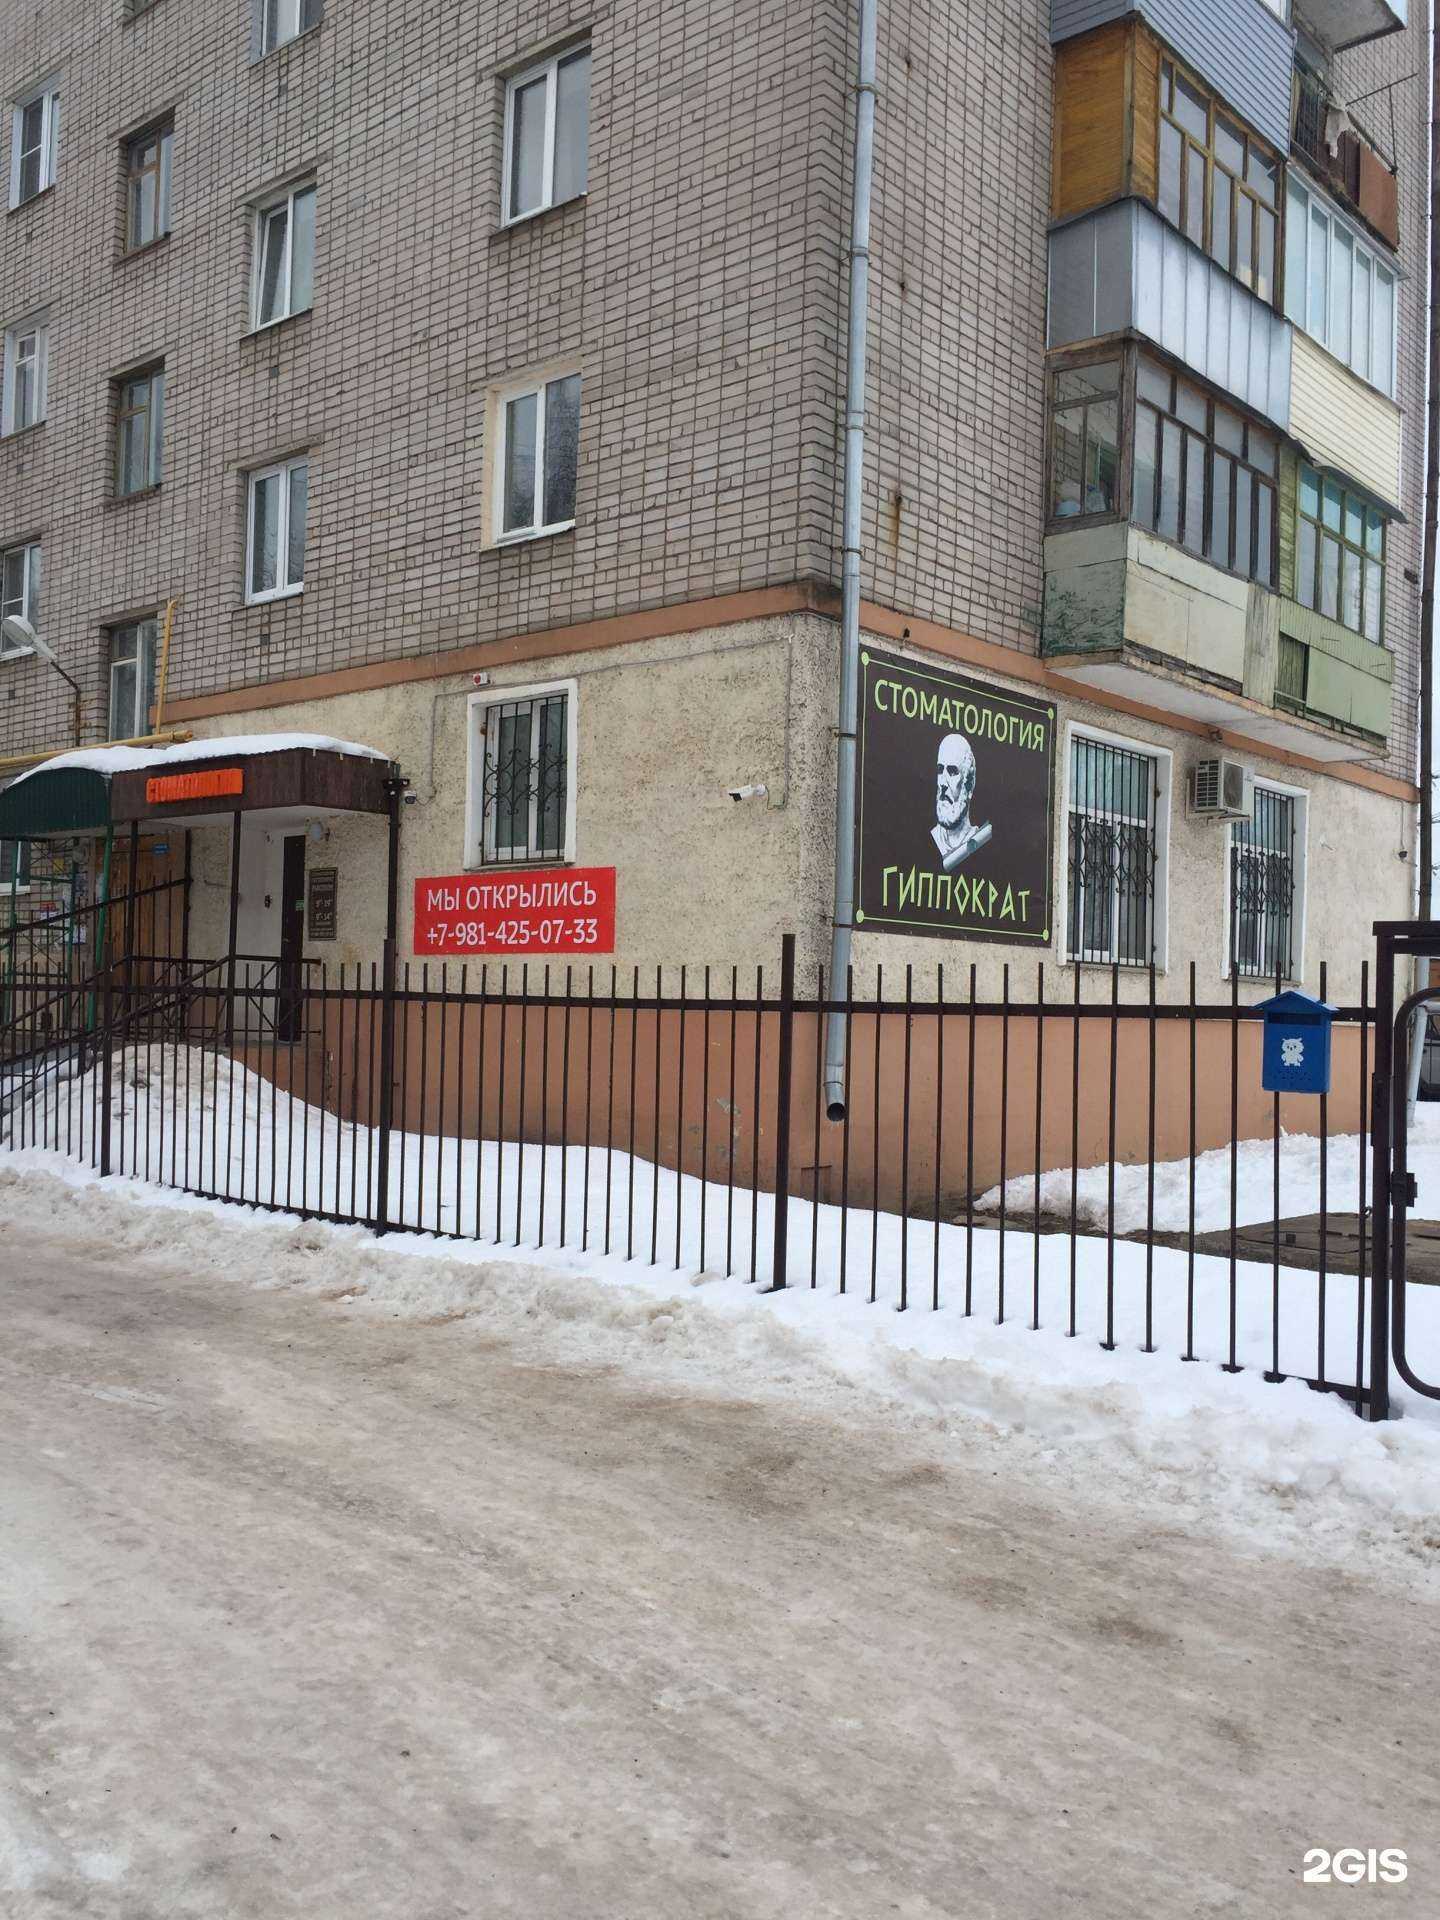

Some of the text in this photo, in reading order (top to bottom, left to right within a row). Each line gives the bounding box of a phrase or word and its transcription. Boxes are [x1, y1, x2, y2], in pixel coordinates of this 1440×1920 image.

[874, 679, 1045, 752] СТОМАТОЛОГИЯ
[427, 881, 597, 912] МЫ ОТКРЫЛИСЬ
[882, 864, 1031, 922] ГИППОКРАТ
[427, 918, 598, 946] +7-981-425-07-33
